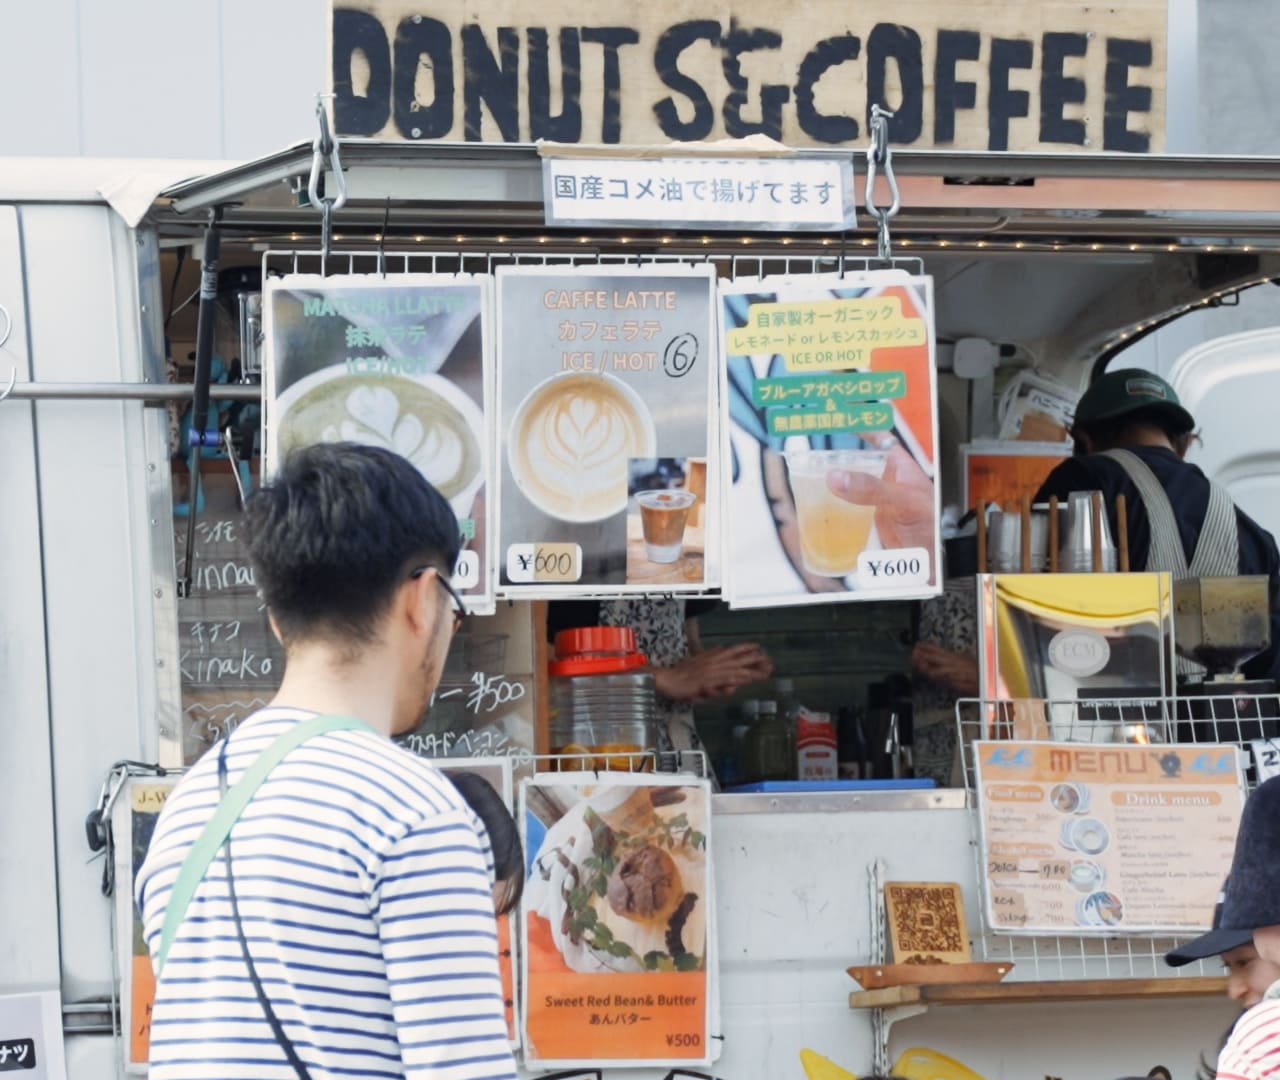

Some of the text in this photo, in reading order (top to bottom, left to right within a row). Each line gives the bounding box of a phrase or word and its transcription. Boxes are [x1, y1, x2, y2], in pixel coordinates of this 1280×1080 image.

[554, 175, 836, 204] 国産コメ油で揚げてます
[304, 295, 464, 316] MATCHA LLATTE
[544, 290, 677, 310] CAFFE LATTE
[757, 305, 894, 328] 自家製オーガニック
[345, 325, 427, 347] 抹茶ラテ
[559, 321, 662, 342] カフェラテ
[733, 328, 919, 349] レモネード or レモンスカッシュ
[562, 353, 592, 371] ICE
[613, 352, 657, 371] HOT
[792, 349, 863, 364] ICE OR HOT
[759, 376, 901, 401] ブルーアガベシロップ
[825, 399, 836, 411] &
[773, 410, 888, 432] 無農薬国産レモン
[517, 550, 572, 576] ¥600
[868, 558, 920, 577] ¥600
[466, 671, 525, 714] ¥500
[1049, 749, 1148, 774] MENU
[1126, 792, 1209, 807] Drink menu
[545, 994, 697, 1008] Sweet Red Bean& Butter
[589, 1012, 651, 1026] あんバター
[666, 1033, 701, 1047] ¥500
